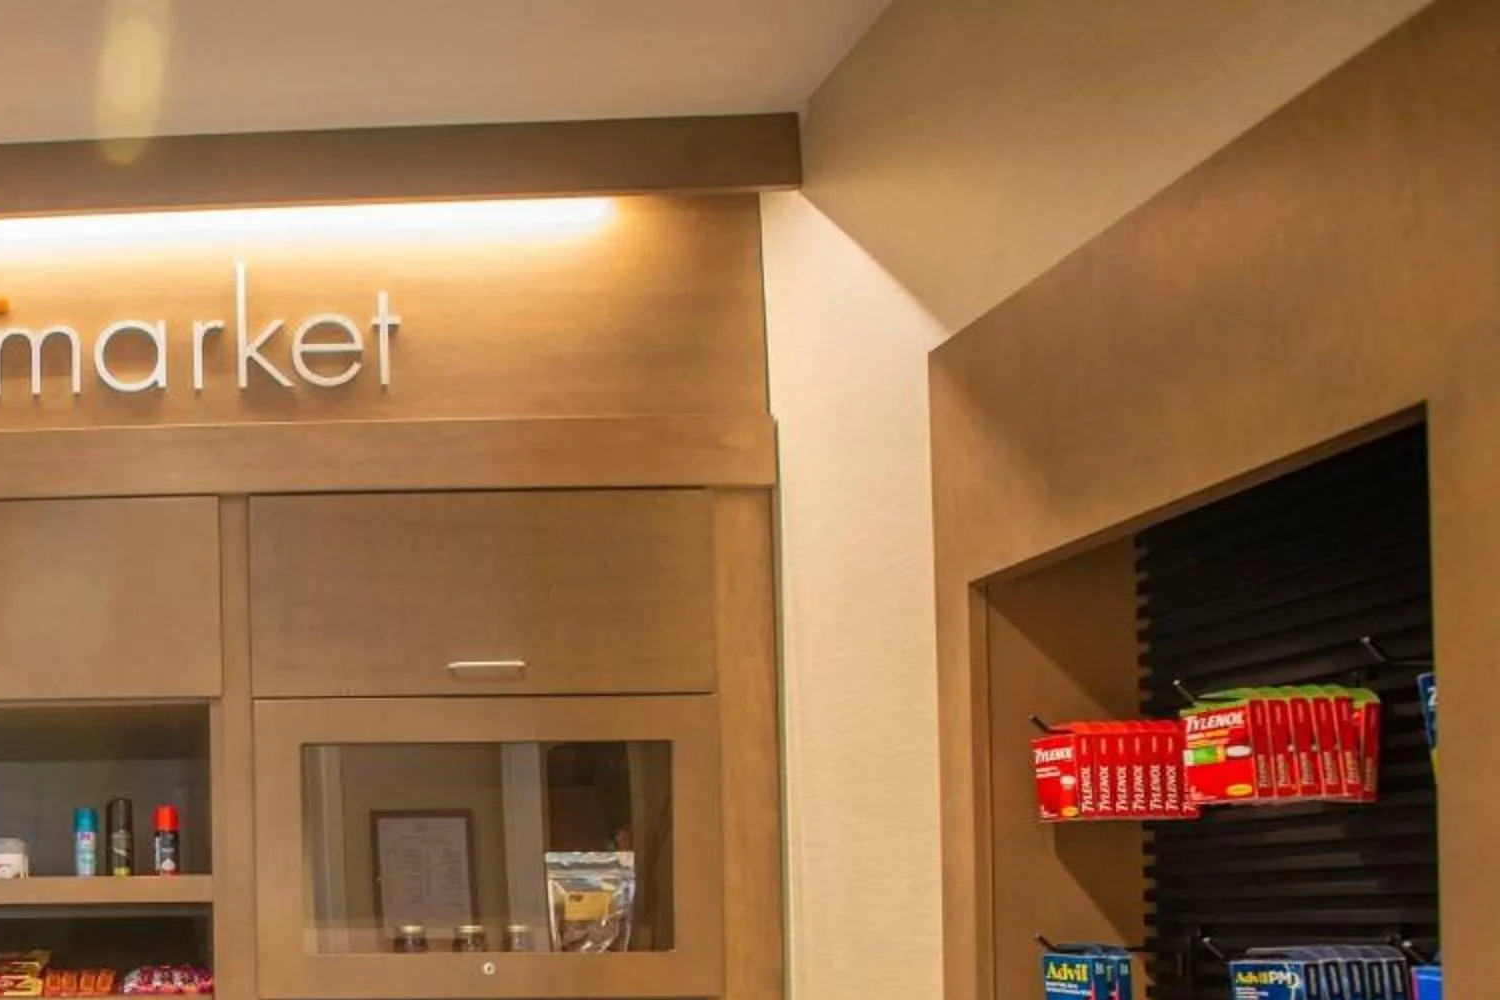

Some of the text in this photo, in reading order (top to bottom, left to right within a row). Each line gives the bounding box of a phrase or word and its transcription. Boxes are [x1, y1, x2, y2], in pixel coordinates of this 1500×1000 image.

[1185, 711, 1244, 733] TYLENOL
[1034, 747, 1073, 764] TYLENOL
[1045, 962, 1089, 982] Advil
[1235, 972, 1269, 985] Advil
